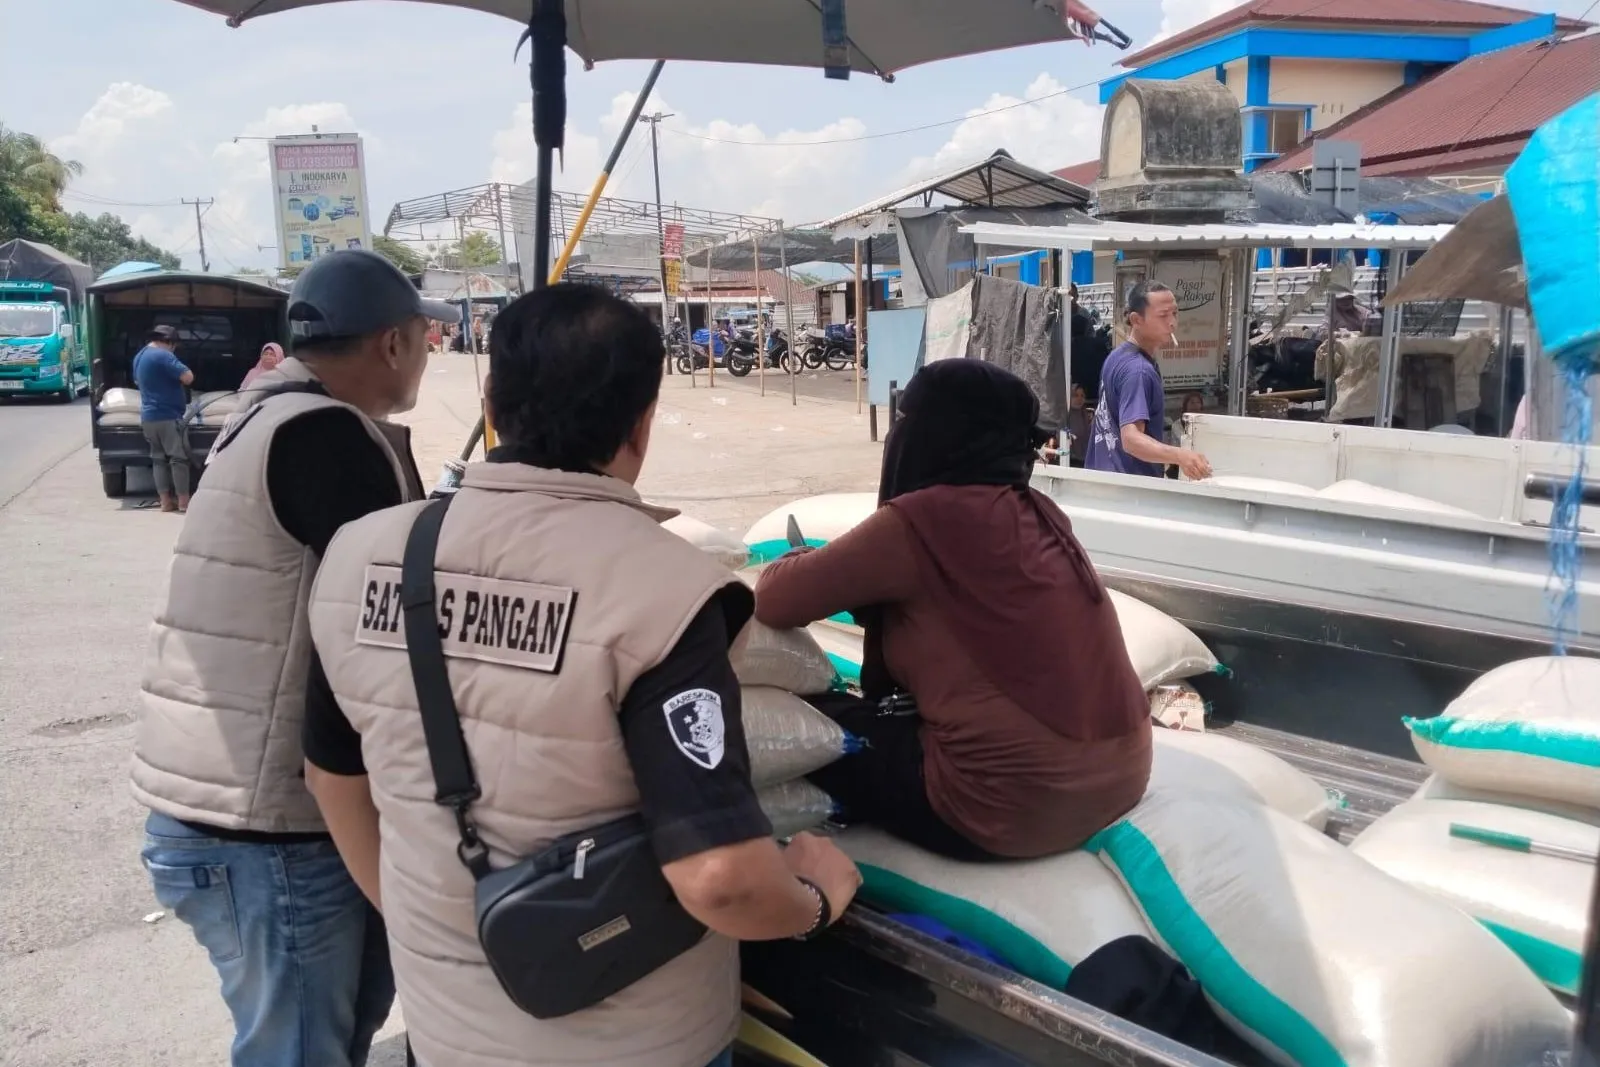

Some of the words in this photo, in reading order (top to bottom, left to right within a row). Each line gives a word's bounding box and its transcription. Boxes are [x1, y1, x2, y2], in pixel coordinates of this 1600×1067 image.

[302, 171, 347, 181] INDOKARYA
[1175, 278, 1205, 290] Pasar
[1183, 289, 1216, 303] Rakyat
[362, 580, 455, 639] SATS
[458, 590, 565, 655] PANGAN
